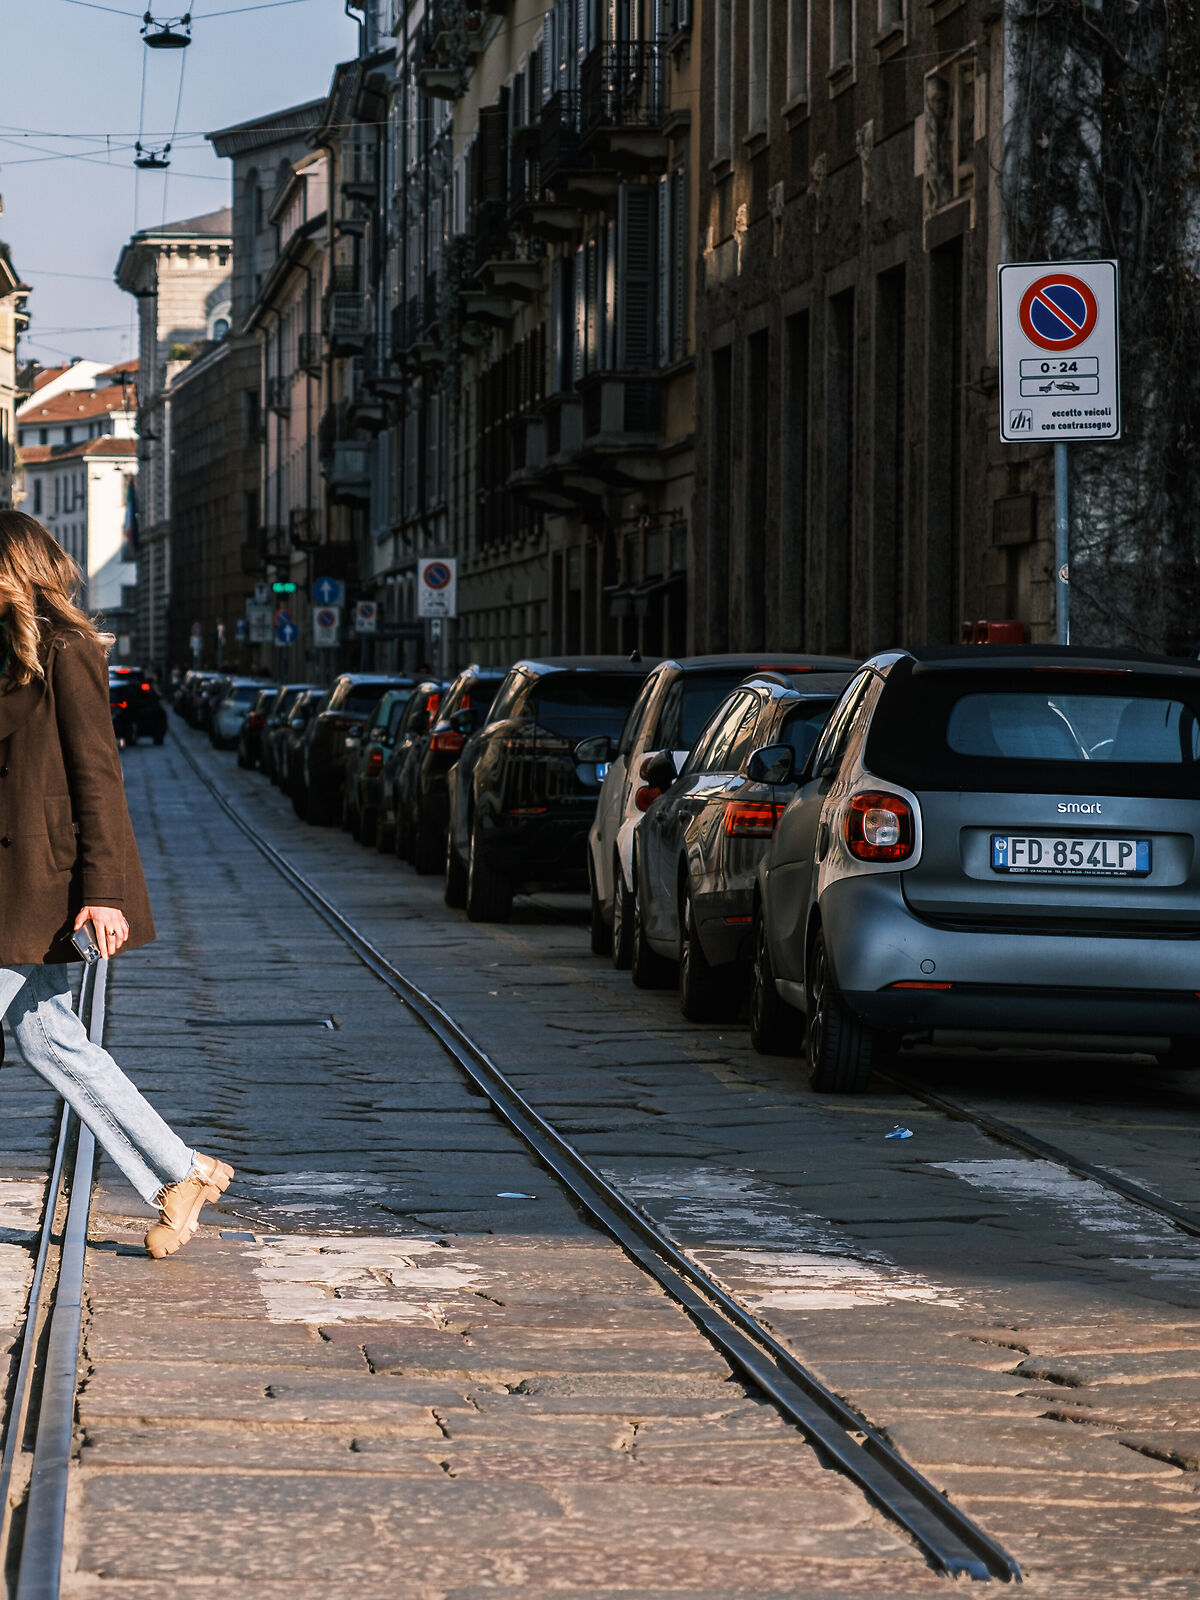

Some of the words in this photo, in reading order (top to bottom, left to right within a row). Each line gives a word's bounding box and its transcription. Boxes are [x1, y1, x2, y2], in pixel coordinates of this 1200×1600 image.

[1051, 408, 1082, 418] eccetto
[1083, 407, 1112, 417] veicoli
[1041, 423, 1056, 431] con
[1057, 421, 1112, 431] contrassegno
[1057, 802, 1102, 814] smart
